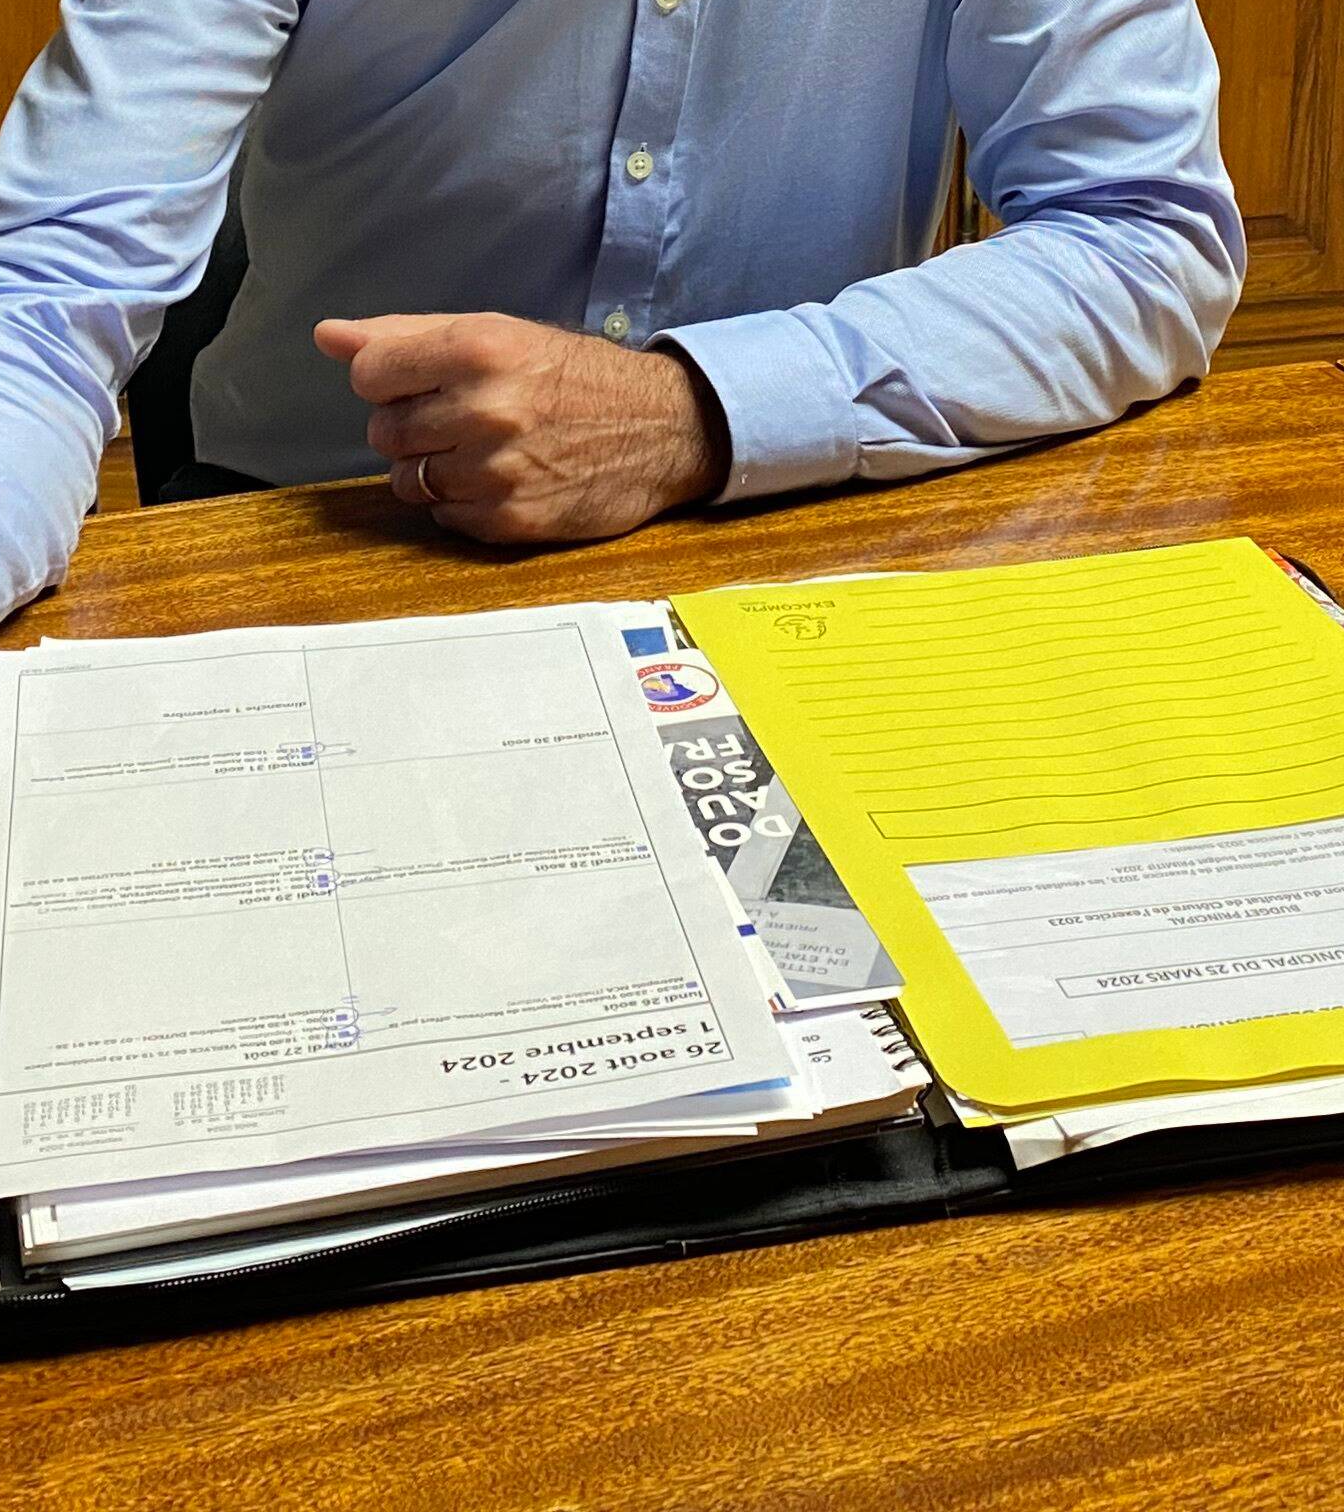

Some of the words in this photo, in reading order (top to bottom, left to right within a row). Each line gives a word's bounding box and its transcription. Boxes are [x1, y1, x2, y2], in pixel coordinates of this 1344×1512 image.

[740, 600, 835, 612] EXACOMPTA
[245, 701, 307, 712] dimanche
[163, 708, 230, 718] septembre
[553, 731, 609, 742] vendredi
[502, 739, 531, 747] août
[215, 766, 244, 774] août
[268, 760, 315, 770] samedi
[697, 785, 769, 820] AU
[703, 814, 792, 849] DO
[590, 853, 651, 867] mercredi
[535, 863, 566, 872] août
[276, 894, 292, 902] 29
[297, 890, 332, 899] jeudi
[1244, 892, 1303, 905] Résultat
[1303, 890, 1322, 898] du
[239, 896, 271, 905] août
[1224, 899, 1243, 907] de
[1152, 907, 1170, 915] de
[1172, 901, 1224, 912] Clôture
[1244, 904, 1301, 918] BUDGET
[1084, 908, 1151, 922] l'exercice
[1167, 910, 1242, 926] PRINCIPAL
[1048, 916, 1083, 926] 2023
[1205, 965, 1229, 976] 25
[1232, 961, 1262, 972] DU
[1145, 967, 1202, 983] MARS
[1096, 974, 1144, 988] 2024
[641, 997, 660, 1006] 26
[664, 991, 703, 1003] lundi
[603, 1001, 637, 1012] août
[700, 1021, 714, 1033] 1
[308, 1040, 353, 1053] mardi
[526, 1024, 687, 1058] septembre
[244, 1050, 279, 1060] août
[284, 1047, 302, 1056] 27
[686, 1041, 723, 1058] 26
[440, 1051, 515, 1073] 2024
[605, 1049, 675, 1070] août
[521, 1062, 597, 1086] 2024
